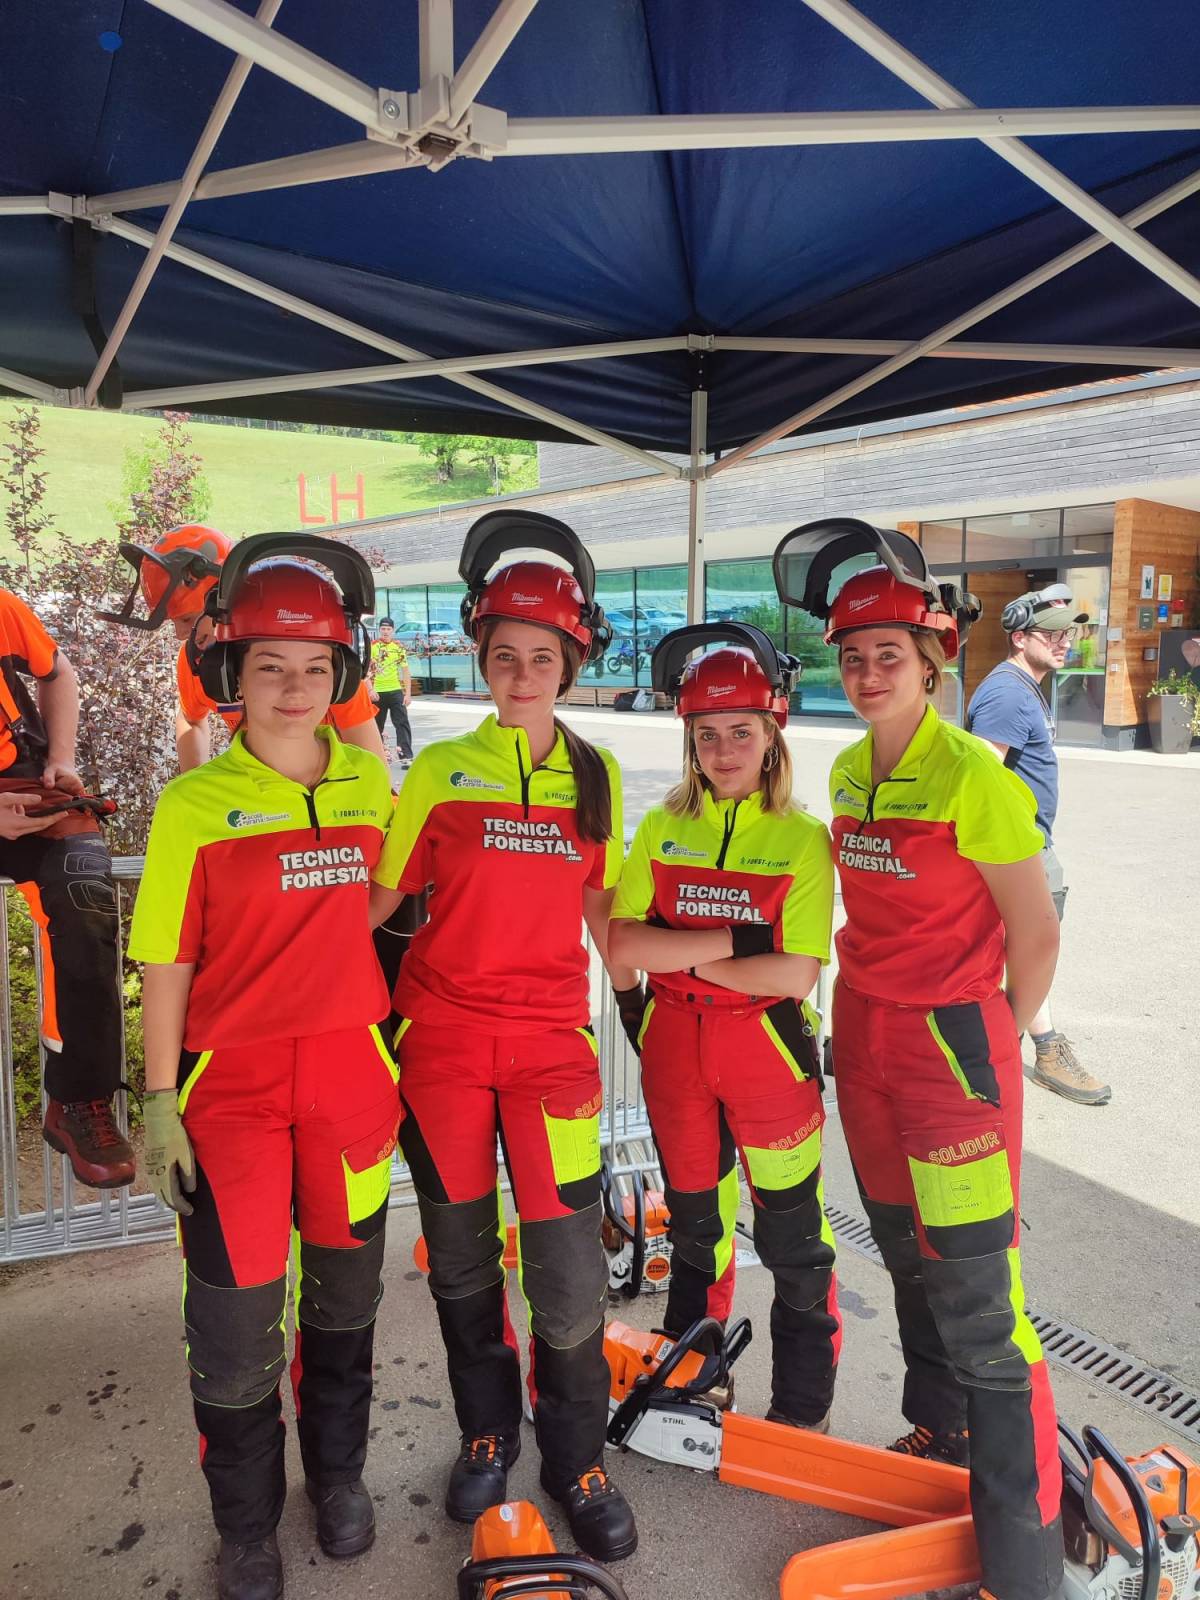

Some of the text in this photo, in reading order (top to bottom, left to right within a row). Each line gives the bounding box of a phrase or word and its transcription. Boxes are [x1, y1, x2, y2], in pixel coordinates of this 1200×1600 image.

[276, 608, 313, 620] Milwaukee
[483, 818, 561, 837] TECNICA
[483, 835, 577, 855] FORESTAL
[841, 832, 891, 854] TECNICA
[279, 846, 364, 870] TECNICA
[839, 850, 907, 873] FORESTAL
[678, 883, 751, 903] TECNICA
[676, 900, 764, 922] FORESTAL
[768, 1111, 822, 1151] SOLIDUR
[928, 1131, 1000, 1165] SOLIDUR
[662, 1416, 687, 1426] STIHL
